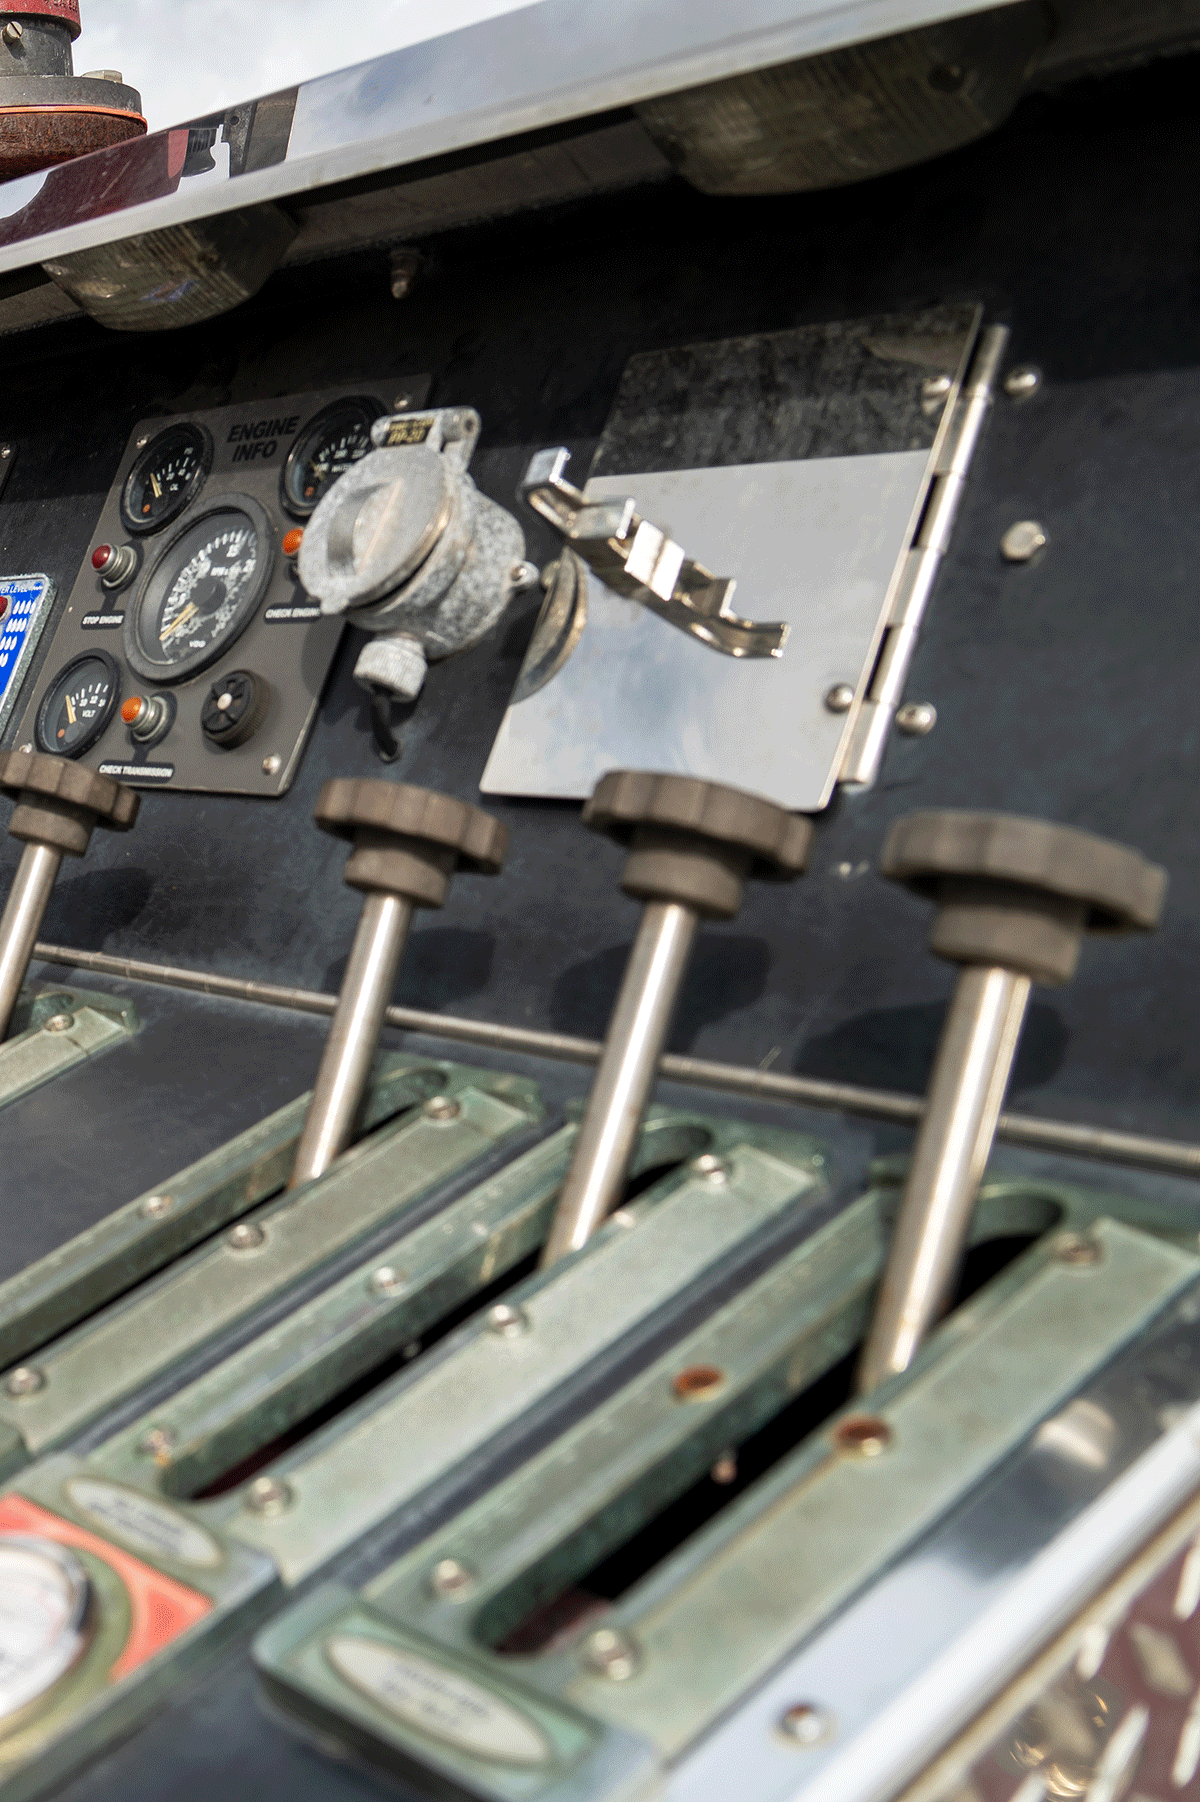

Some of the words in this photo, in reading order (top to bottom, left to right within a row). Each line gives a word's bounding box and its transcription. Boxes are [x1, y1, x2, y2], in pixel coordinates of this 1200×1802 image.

[227, 415, 300, 442] ENGINE
[232, 440, 277, 462] INFO
[265, 609, 292, 618] CHECK
[82, 616, 100, 625] STOP
[99, 615, 124, 624] ENGINE
[82, 709, 96, 718] VOLT
[99, 764, 123, 774] CHECK
[122, 765, 173, 777] TRANSMISSION
